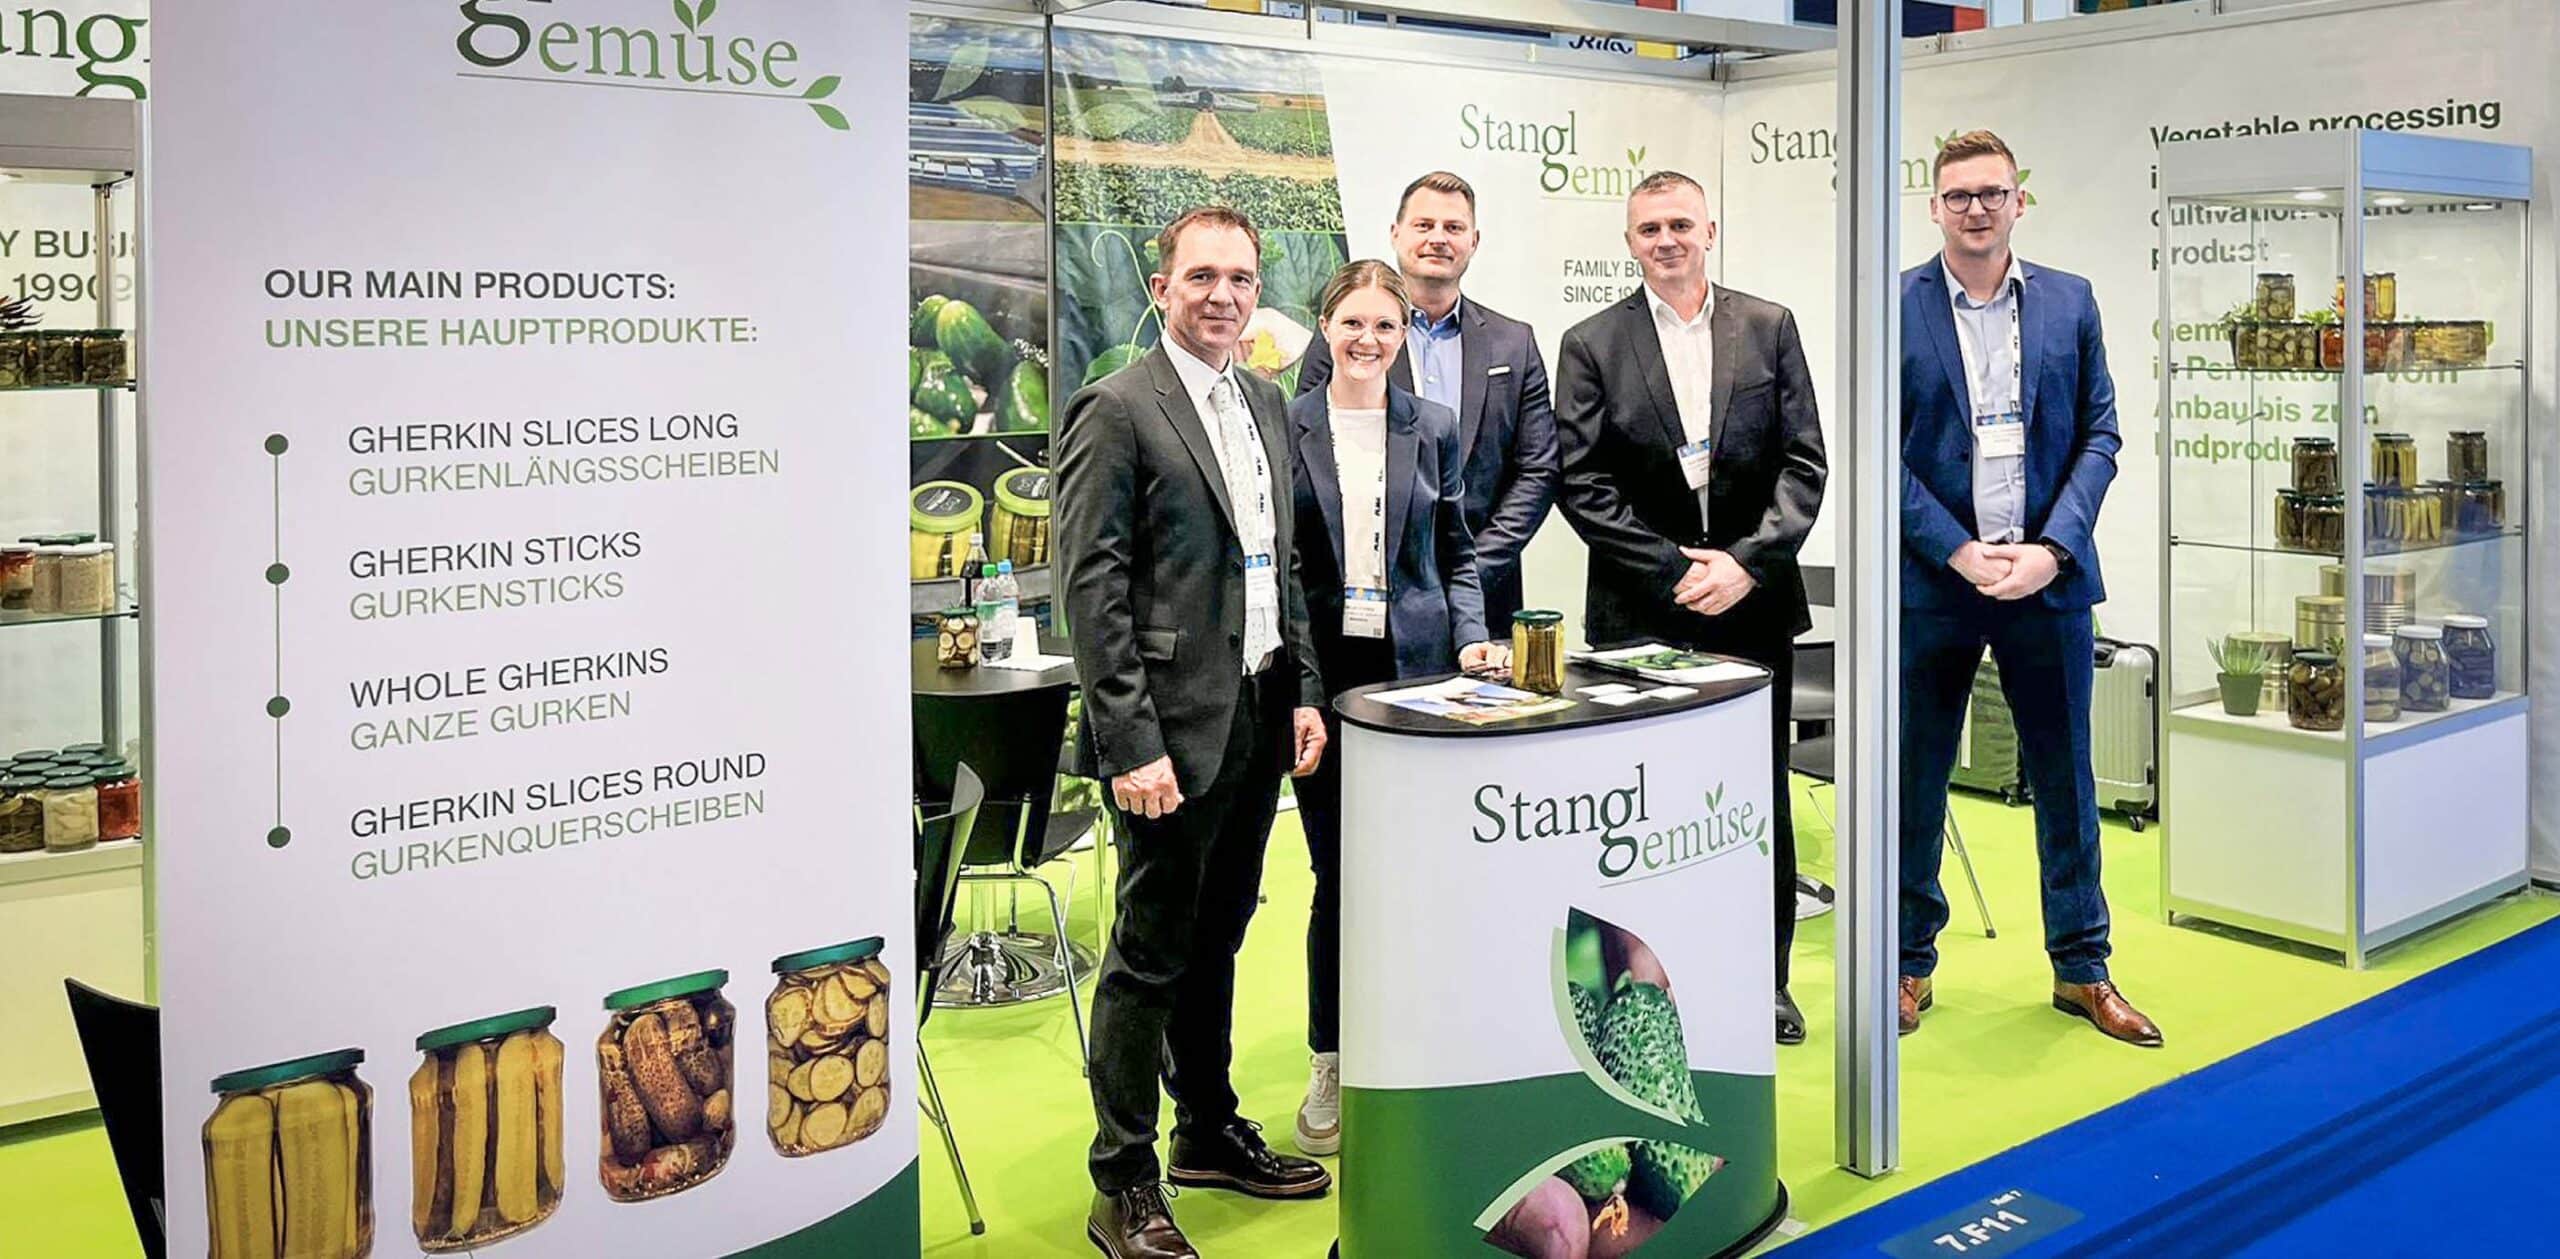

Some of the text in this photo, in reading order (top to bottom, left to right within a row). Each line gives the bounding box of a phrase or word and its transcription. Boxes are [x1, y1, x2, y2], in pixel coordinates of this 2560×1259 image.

[265, 269, 675, 299] OUR MAIN PRODUCTS:
[1563, 260, 1620, 278] FAMILY
[1563, 285, 1614, 303] SINCE
[266, 318, 757, 348] UNSERE HAUPTPRODUKTE:
[349, 413, 738, 454] GHERKIN SLICES LONG
[348, 449, 781, 496] GURKENLÄNGSSCHEIBEN
[349, 531, 641, 582] GHERKIN STICKS
[350, 573, 625, 621] GURKENSTICKS
[349, 648, 670, 709] WHOLE GHERKINS
[350, 691, 631, 750] GANZE GURKEN
[350, 752, 766, 837] GHERKIN SLICES ROUND
[351, 790, 765, 880] GURKENQUERSCHEIBEN
[1472, 762, 1650, 878] Stangl
[1933, 1210, 2028, 1252] 7.F11
